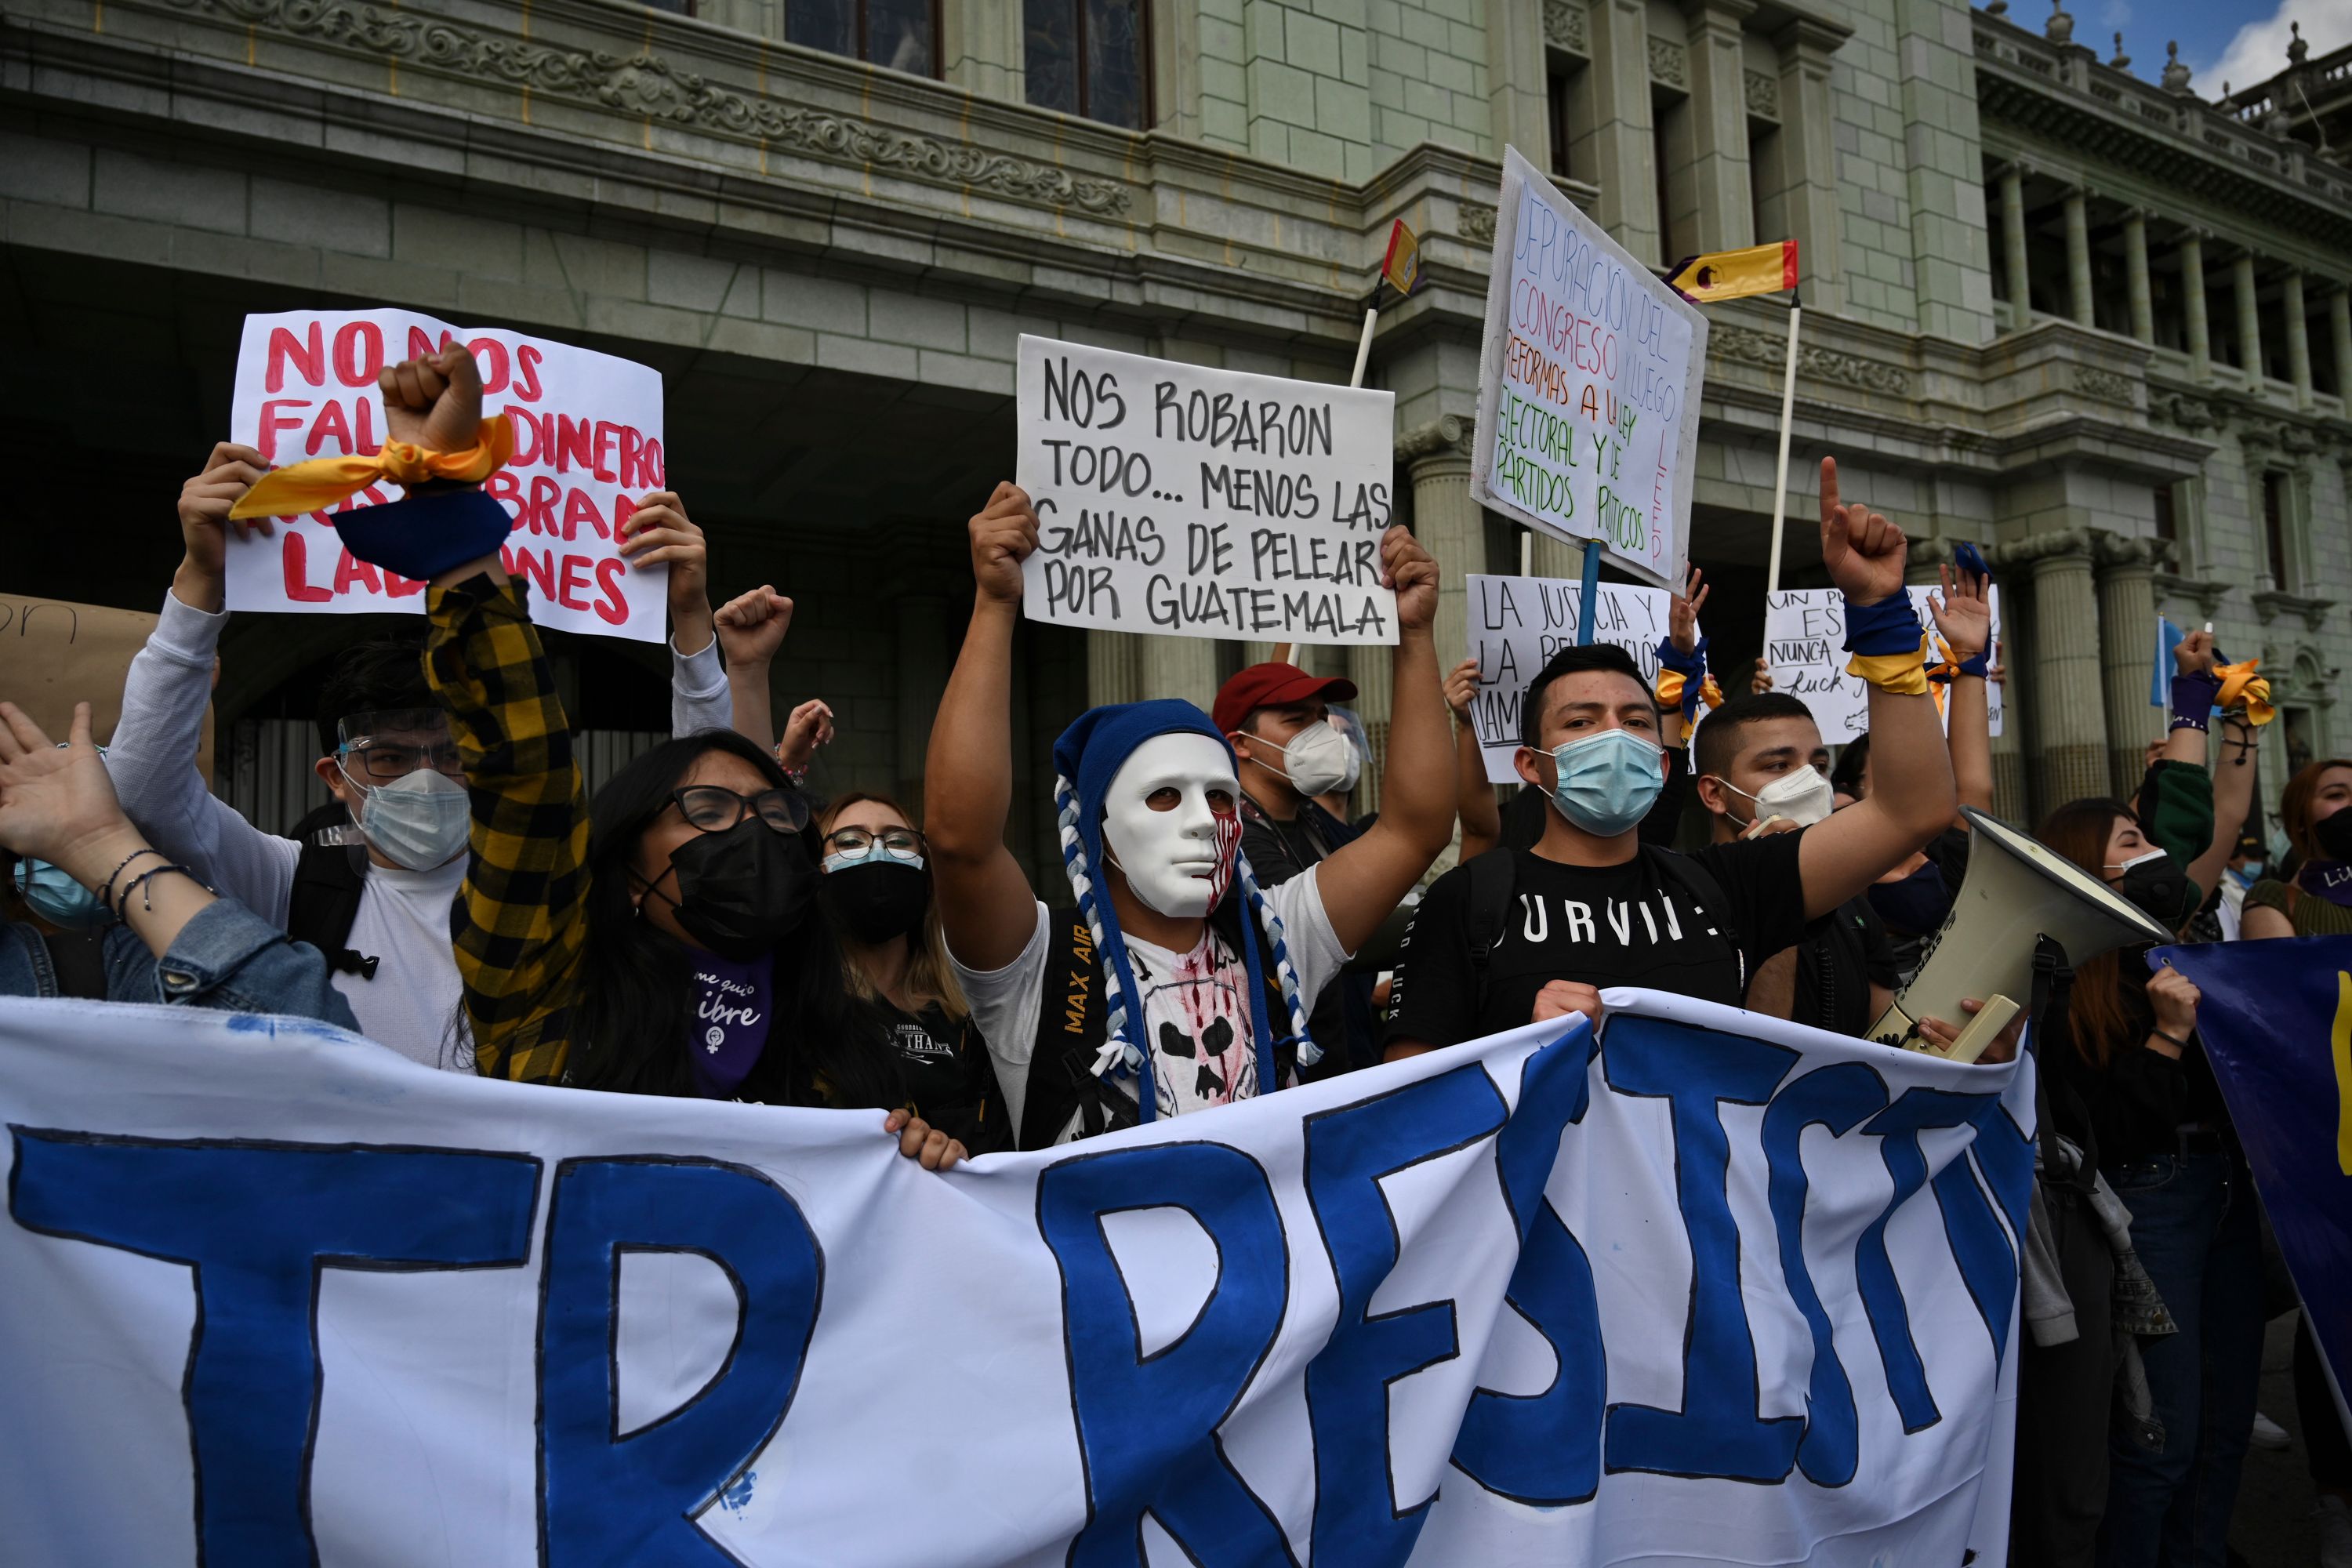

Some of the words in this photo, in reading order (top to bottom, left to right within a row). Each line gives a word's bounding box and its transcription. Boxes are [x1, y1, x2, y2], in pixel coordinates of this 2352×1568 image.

[265, 321, 384, 393] NO
[1515, 278, 1617, 381] CONGRESO
[1631, 354, 1675, 422] LUEGO
[1638, 294, 1668, 363] DEL
[1044, 357, 1126, 429] NOS
[1155, 381, 1332, 459] ROBARON
[1504, 328, 1568, 405] REFORMAS
[1581, 384, 1599, 421] A
[1606, 389, 1617, 427] LA
[1618, 401, 1637, 447] LEY
[504, 405, 665, 489] DINERO
[1497, 384, 1577, 467] ELECTORAL
[1593, 433, 1607, 474] Y
[1041, 438, 1184, 503] TODO...
[1200, 461, 1319, 518] MENOS
[1333, 481, 1392, 532] LAS
[1495, 441, 1573, 518] PARTIDOS
[1036, 498, 1166, 567] GANAS
[1188, 522, 1233, 576] DE
[1251, 528, 1383, 586] PELEAR
[1044, 558, 1121, 619] POR
[1145, 573, 1386, 637] GUATEMALA
[1481, 580, 1523, 630] LA
[1538, 583, 1628, 631] JUSTCIA
[1635, 593, 1656, 632] Y
[1768, 592, 1809, 610] UN
[1479, 638, 1518, 685] LA
[1769, 639, 1833, 667] NUNCA
[1073, 924, 1092, 965] AIR
[1904, 932, 1943, 993] STEREN
[698, 990, 761, 1026] ibre
[1064, 970, 1090, 1034] MAX
[1388, 964, 1405, 1019] LUCK
